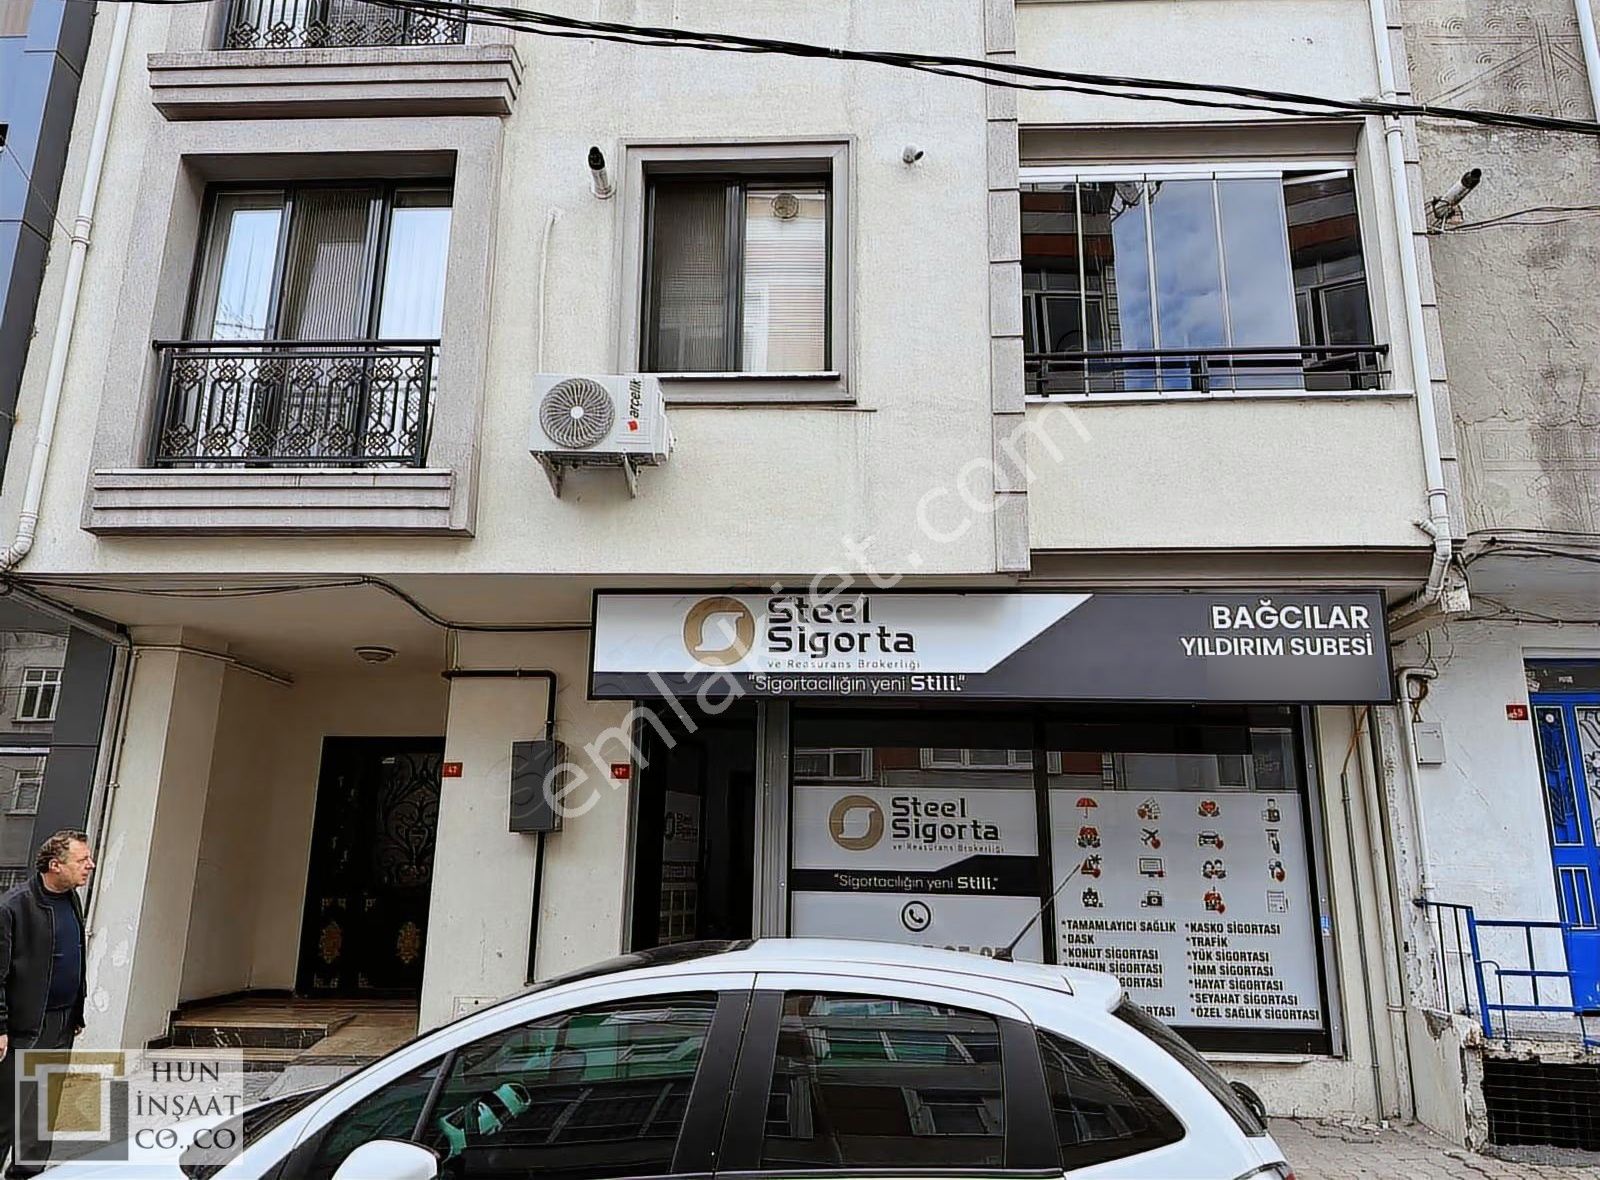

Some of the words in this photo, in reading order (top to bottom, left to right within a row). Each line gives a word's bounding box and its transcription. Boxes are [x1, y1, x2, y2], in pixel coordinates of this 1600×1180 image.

[629, 378, 642, 419] arçelik
[767, 596, 871, 624] Steel
[1211, 599, 1370, 629] BAĞCILAR
[767, 625, 916, 659] Sigorta
[1180, 636, 1284, 656] YILDIRIM
[1289, 632, 1375, 656] SUBESİ
[748, 674, 866, 695] "Sigortacılığın
[870, 675, 906, 694] yeni
[911, 674, 965, 691] Stili."
[891, 796, 966, 818] Steel
[891, 818, 1000, 843] Sigorta
[927, 875, 954, 891] yeni
[957, 876, 999, 890] Stili."
[1066, 919, 1137, 931] TAMAMLAYICI
[1140, 919, 1176, 932] SAĞLIK
[1189, 922, 1224, 933] KASKO
[1227, 921, 1281, 934] SİGORTASI
[1067, 934, 1095, 944] DASK
[1191, 935, 1228, 947] TRAFİK
[1068, 948, 1102, 958] KONUT
[1105, 946, 1159, 959] SİGORTASI
[1192, 949, 1213, 961] YÜK
[1215, 950, 1269, 962] SİGORTASI
[1109, 960, 1163, 974] SİGORTASI
[1193, 963, 1217, 975] İMM
[1219, 963, 1274, 976] SİGORTASI
[1119, 976, 1163, 988] GORTASI
[1194, 979, 1226, 989] HAYAT
[1229, 977, 1283, 991] SİGORTASI
[1195, 993, 1240, 1004] SEYAHAT
[1243, 991, 1298, 1005] SİGORTASI
[1225, 1006, 1262, 1019] SAĞLIK
[1264, 1006, 1320, 1020] SİGORTASI
